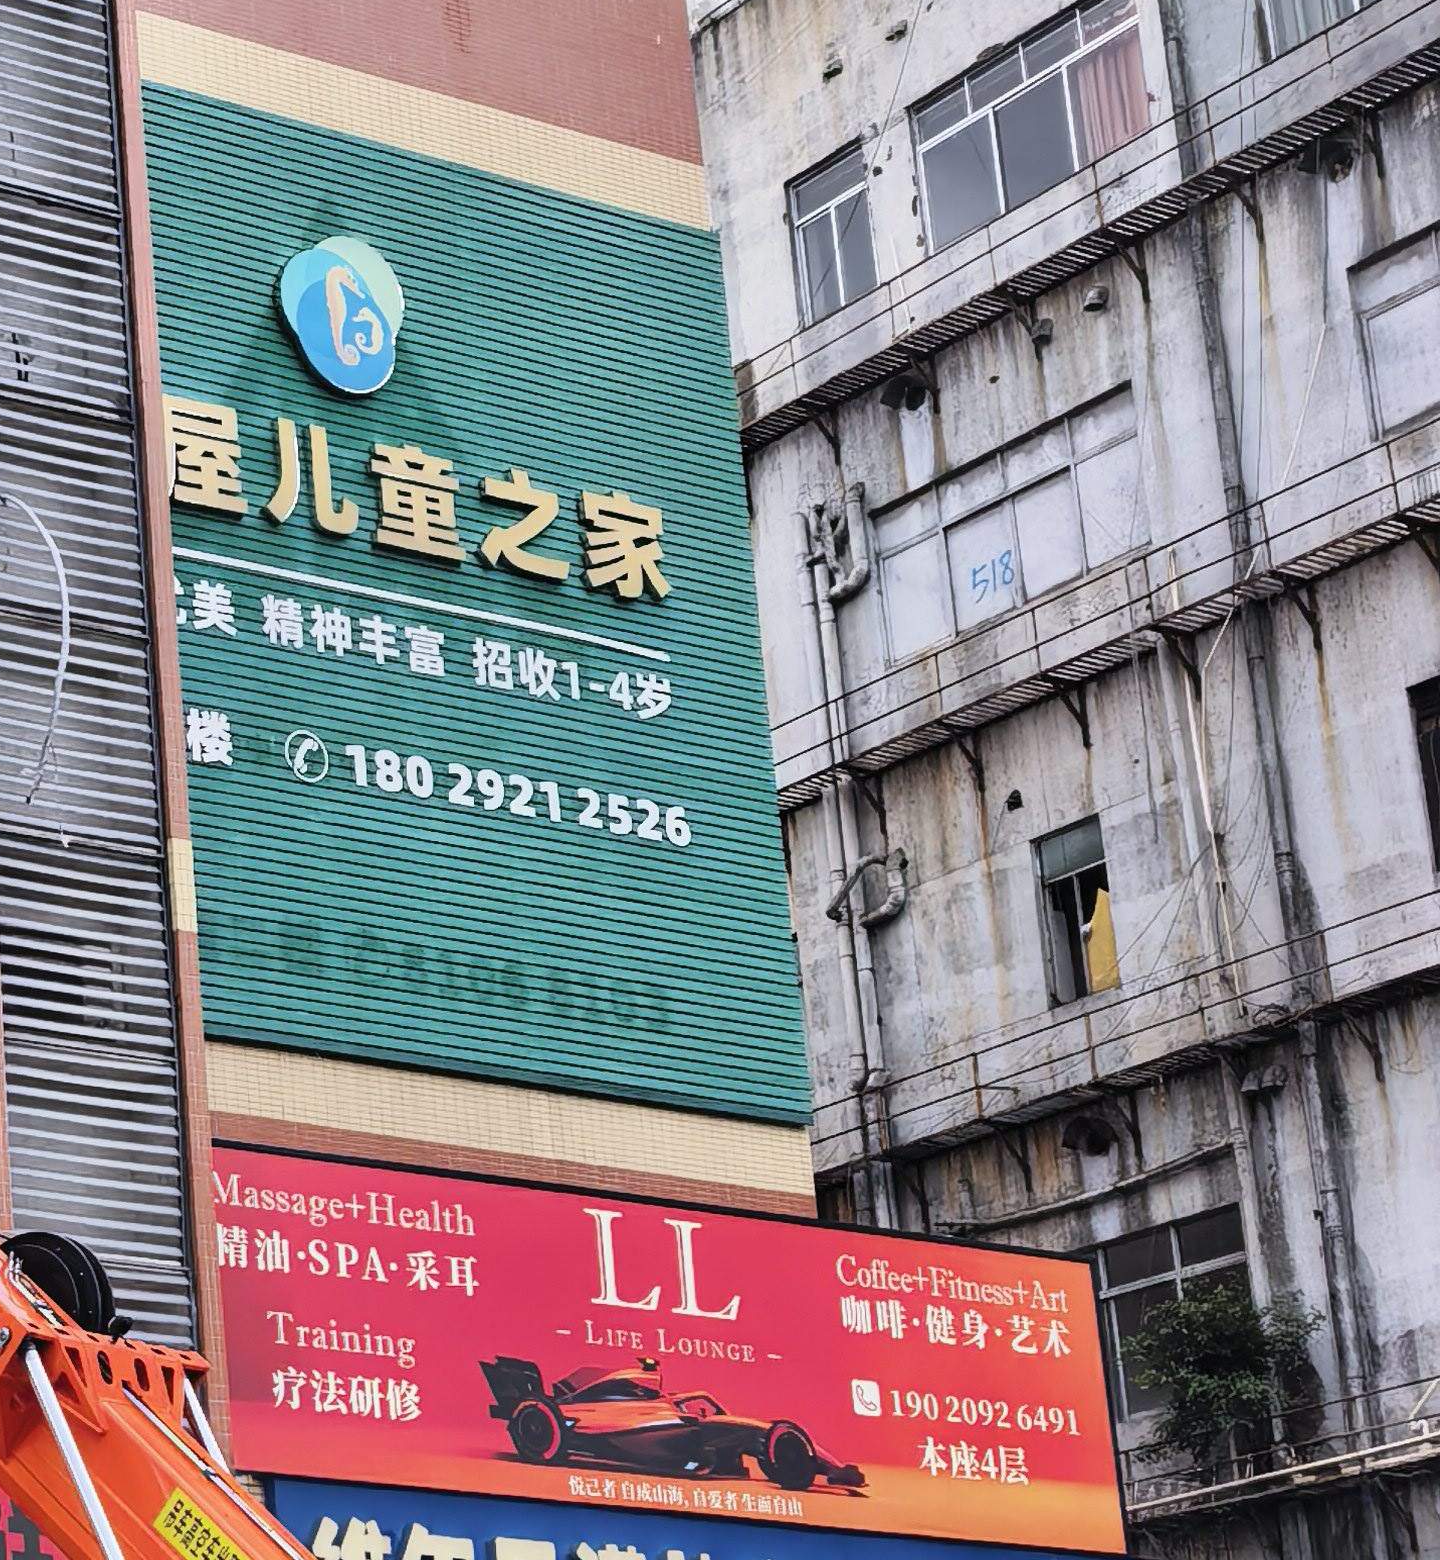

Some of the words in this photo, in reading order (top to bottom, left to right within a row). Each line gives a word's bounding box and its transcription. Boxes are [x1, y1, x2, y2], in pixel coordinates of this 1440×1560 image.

[162, 394, 672, 600] 屋儿童之家
[968, 547, 1017, 604] 518
[261, 593, 446, 677] 精神丰富
[472, 636, 673, 721] 招收1-4岁
[345, 743, 434, 800] 180
[447, 763, 562, 823] 2921
[576, 787, 693, 847] 2526
[212, 1171, 477, 1237] Massage+Health
[583, 1206, 743, 1321] LL
[835, 1253, 1070, 1314] Coffee+Fitness+Art
[266, 1310, 417, 1370] Training
[272, 1366, 423, 1422] 疗法研修
[889, 1389, 939, 1422] 190
[945, 1395, 1011, 1429] 2092
[1016, 1403, 1082, 1437] 6491
[917, 1435, 1031, 1486] 本座4层
